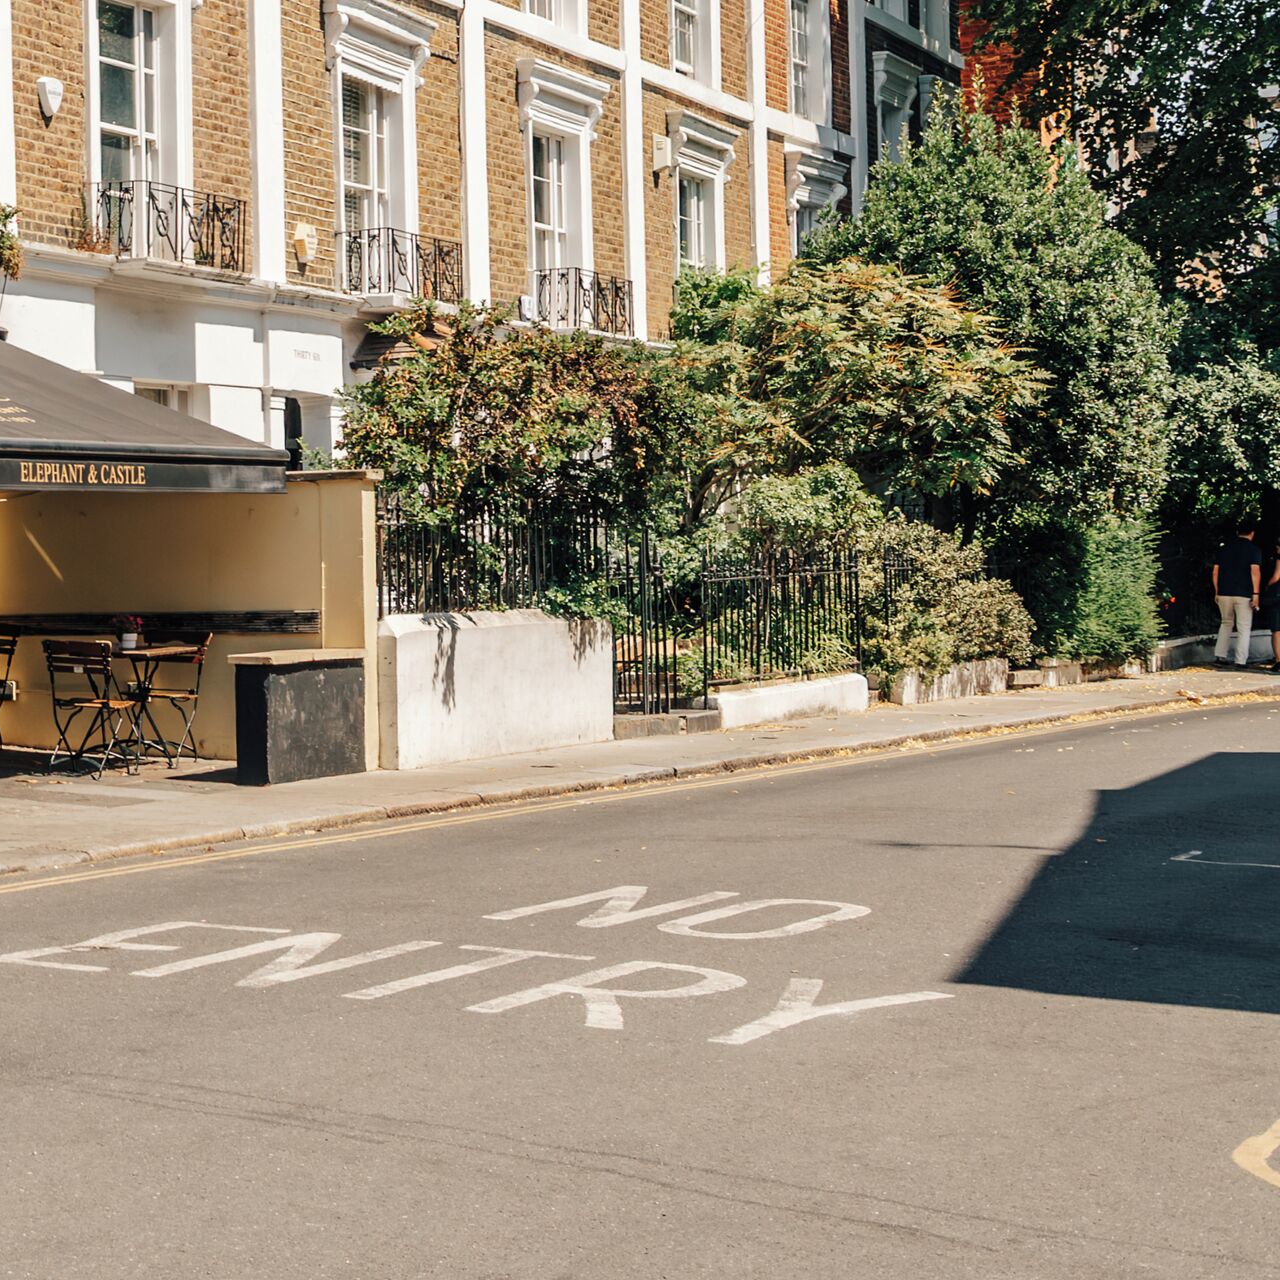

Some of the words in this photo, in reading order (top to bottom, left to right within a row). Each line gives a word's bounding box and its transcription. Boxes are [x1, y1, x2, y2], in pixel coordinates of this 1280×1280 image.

[20, 462, 85, 484] ELEPHANT
[87, 464, 98, 484] &
[100, 464, 146, 485] CASTLE
[482, 885, 872, 940] NO
